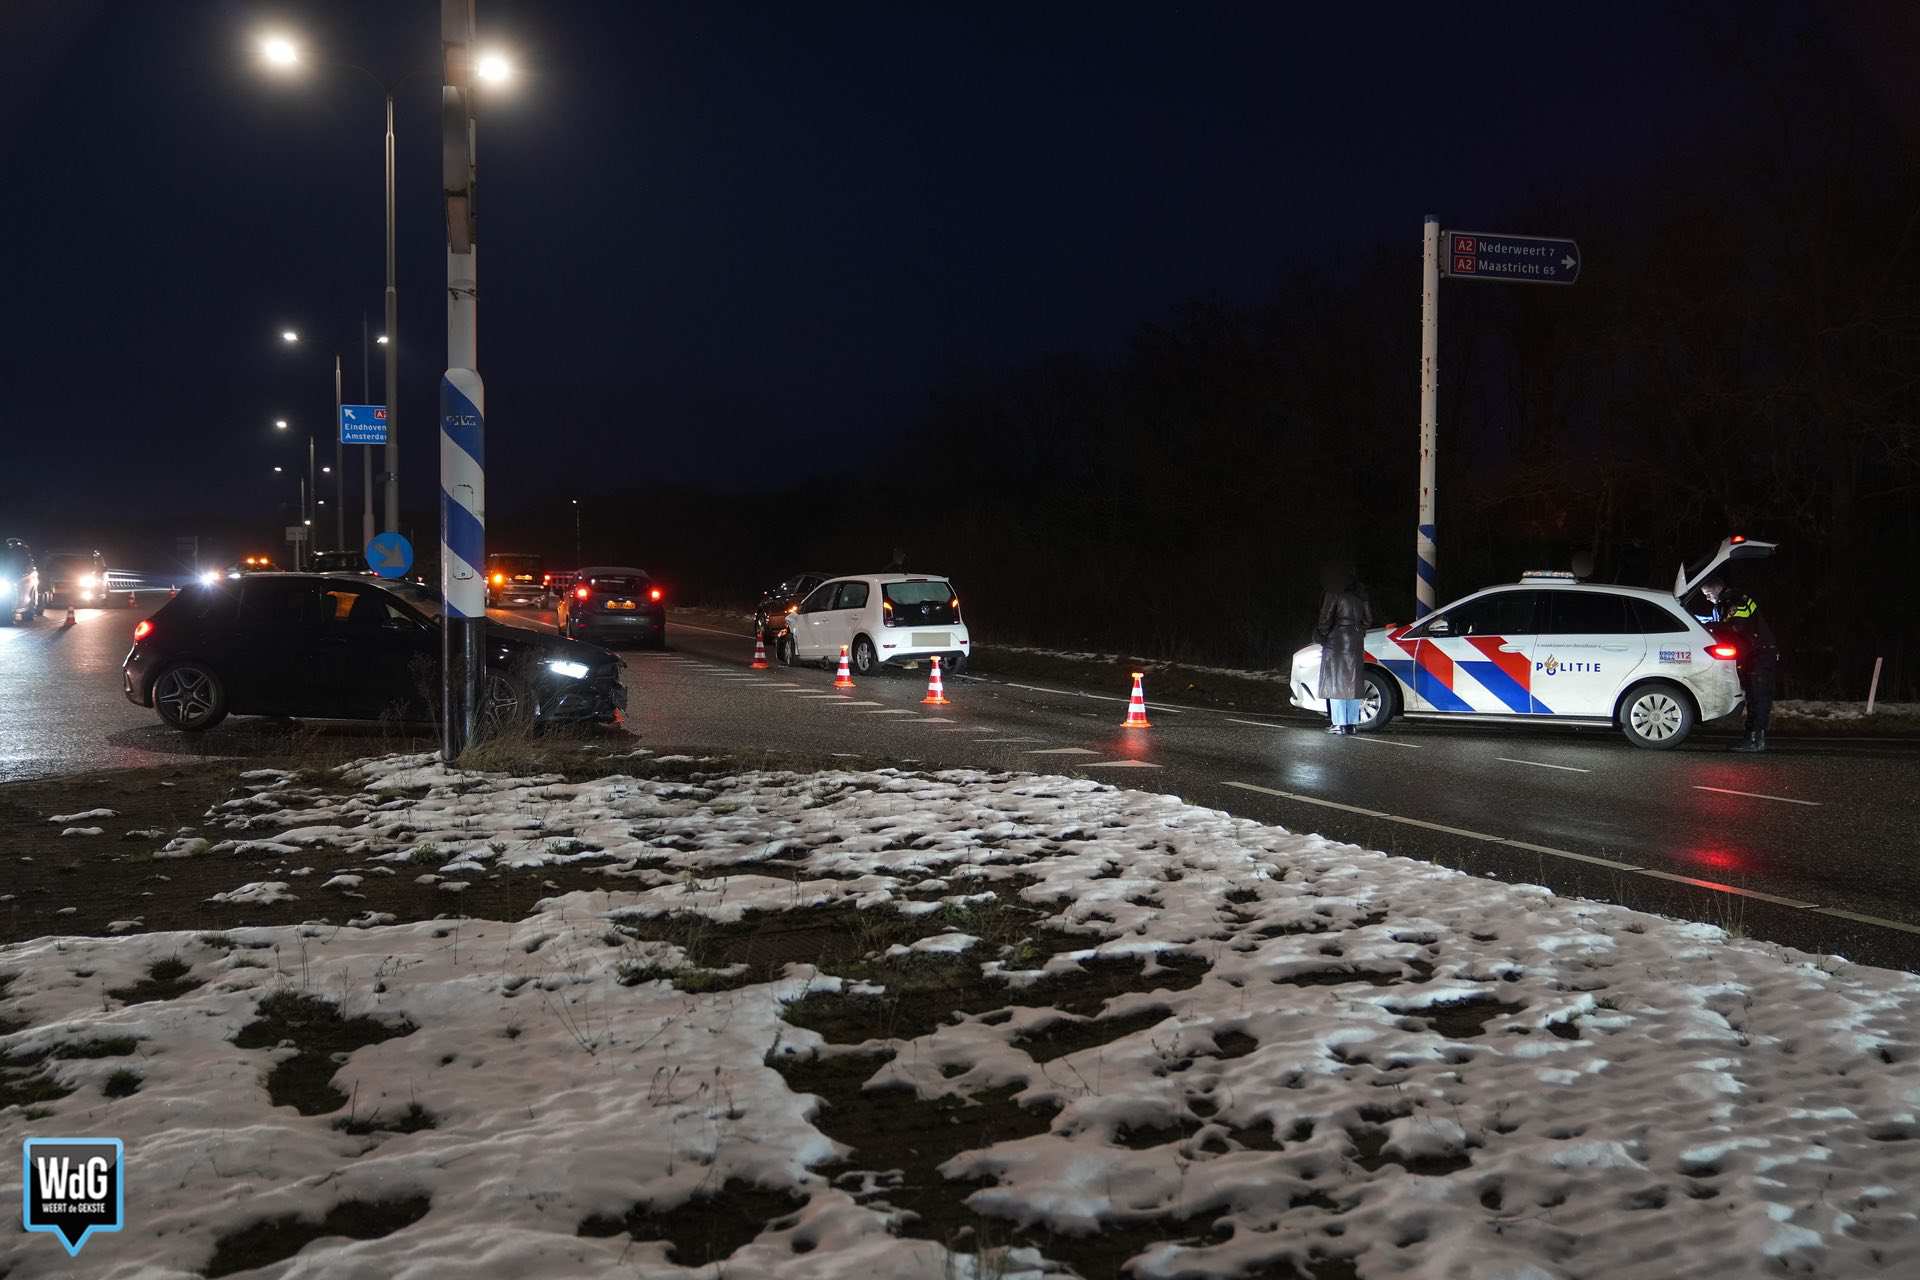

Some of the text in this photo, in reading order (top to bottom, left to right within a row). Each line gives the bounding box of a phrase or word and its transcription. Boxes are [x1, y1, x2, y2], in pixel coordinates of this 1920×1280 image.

[1458, 239, 1473, 251] A2
[1480, 241, 1546, 257] Nederweert
[1457, 258, 1472, 270] A2
[1479, 260, 1540, 274] Maastricht
[344, 423, 387, 431] Eindhoven
[1675, 651, 1691, 659] 112
[1536, 661, 1601, 676] POLITIE
